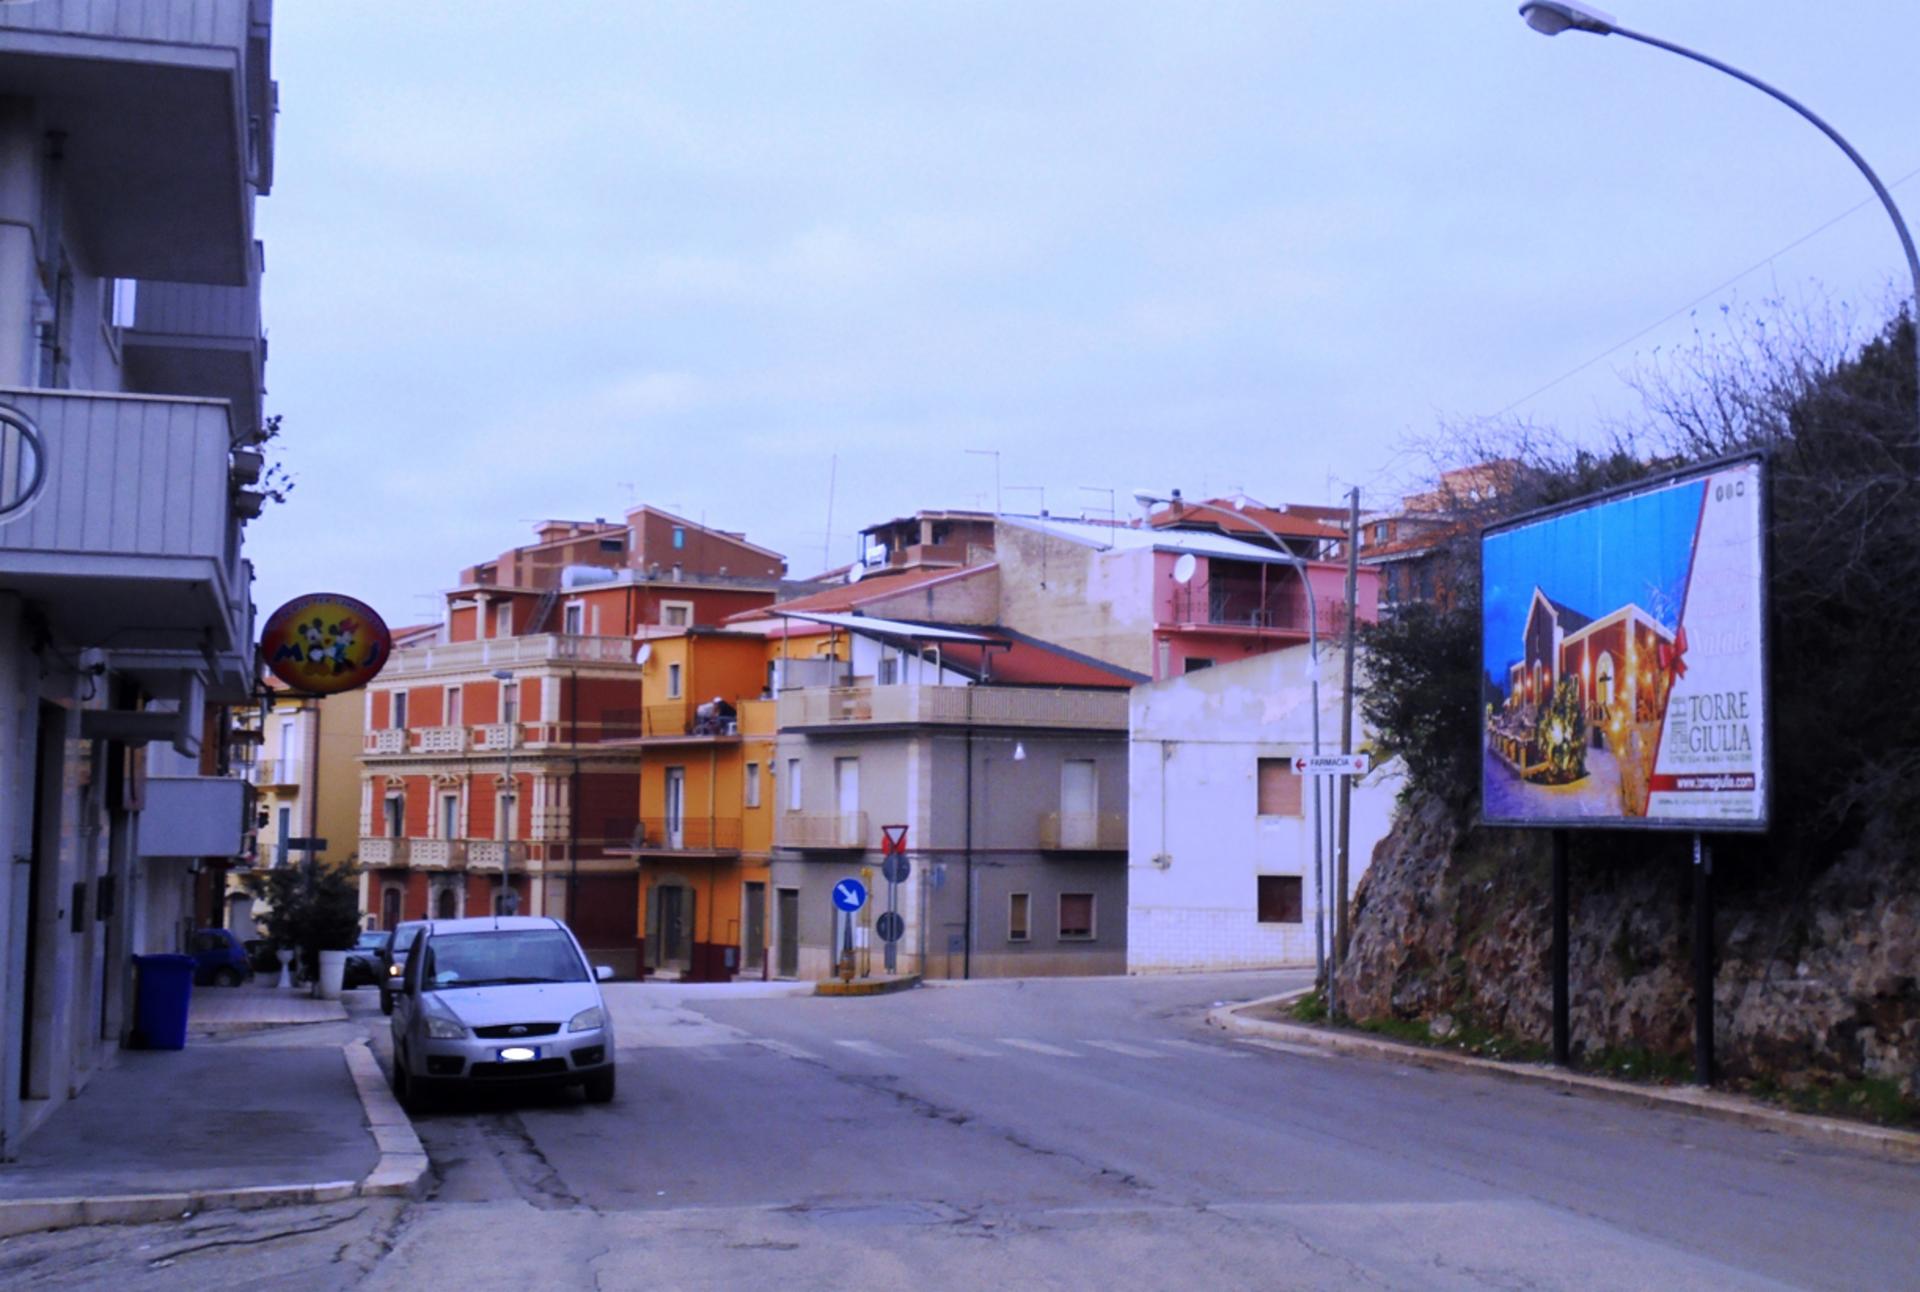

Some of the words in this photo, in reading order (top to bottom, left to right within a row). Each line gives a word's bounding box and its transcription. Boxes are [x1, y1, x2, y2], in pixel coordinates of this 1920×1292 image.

[1689, 691, 1750, 722] TORRE
[1687, 723, 1752, 754] GIULIA
[1310, 758, 1349, 766] FARMACIA
